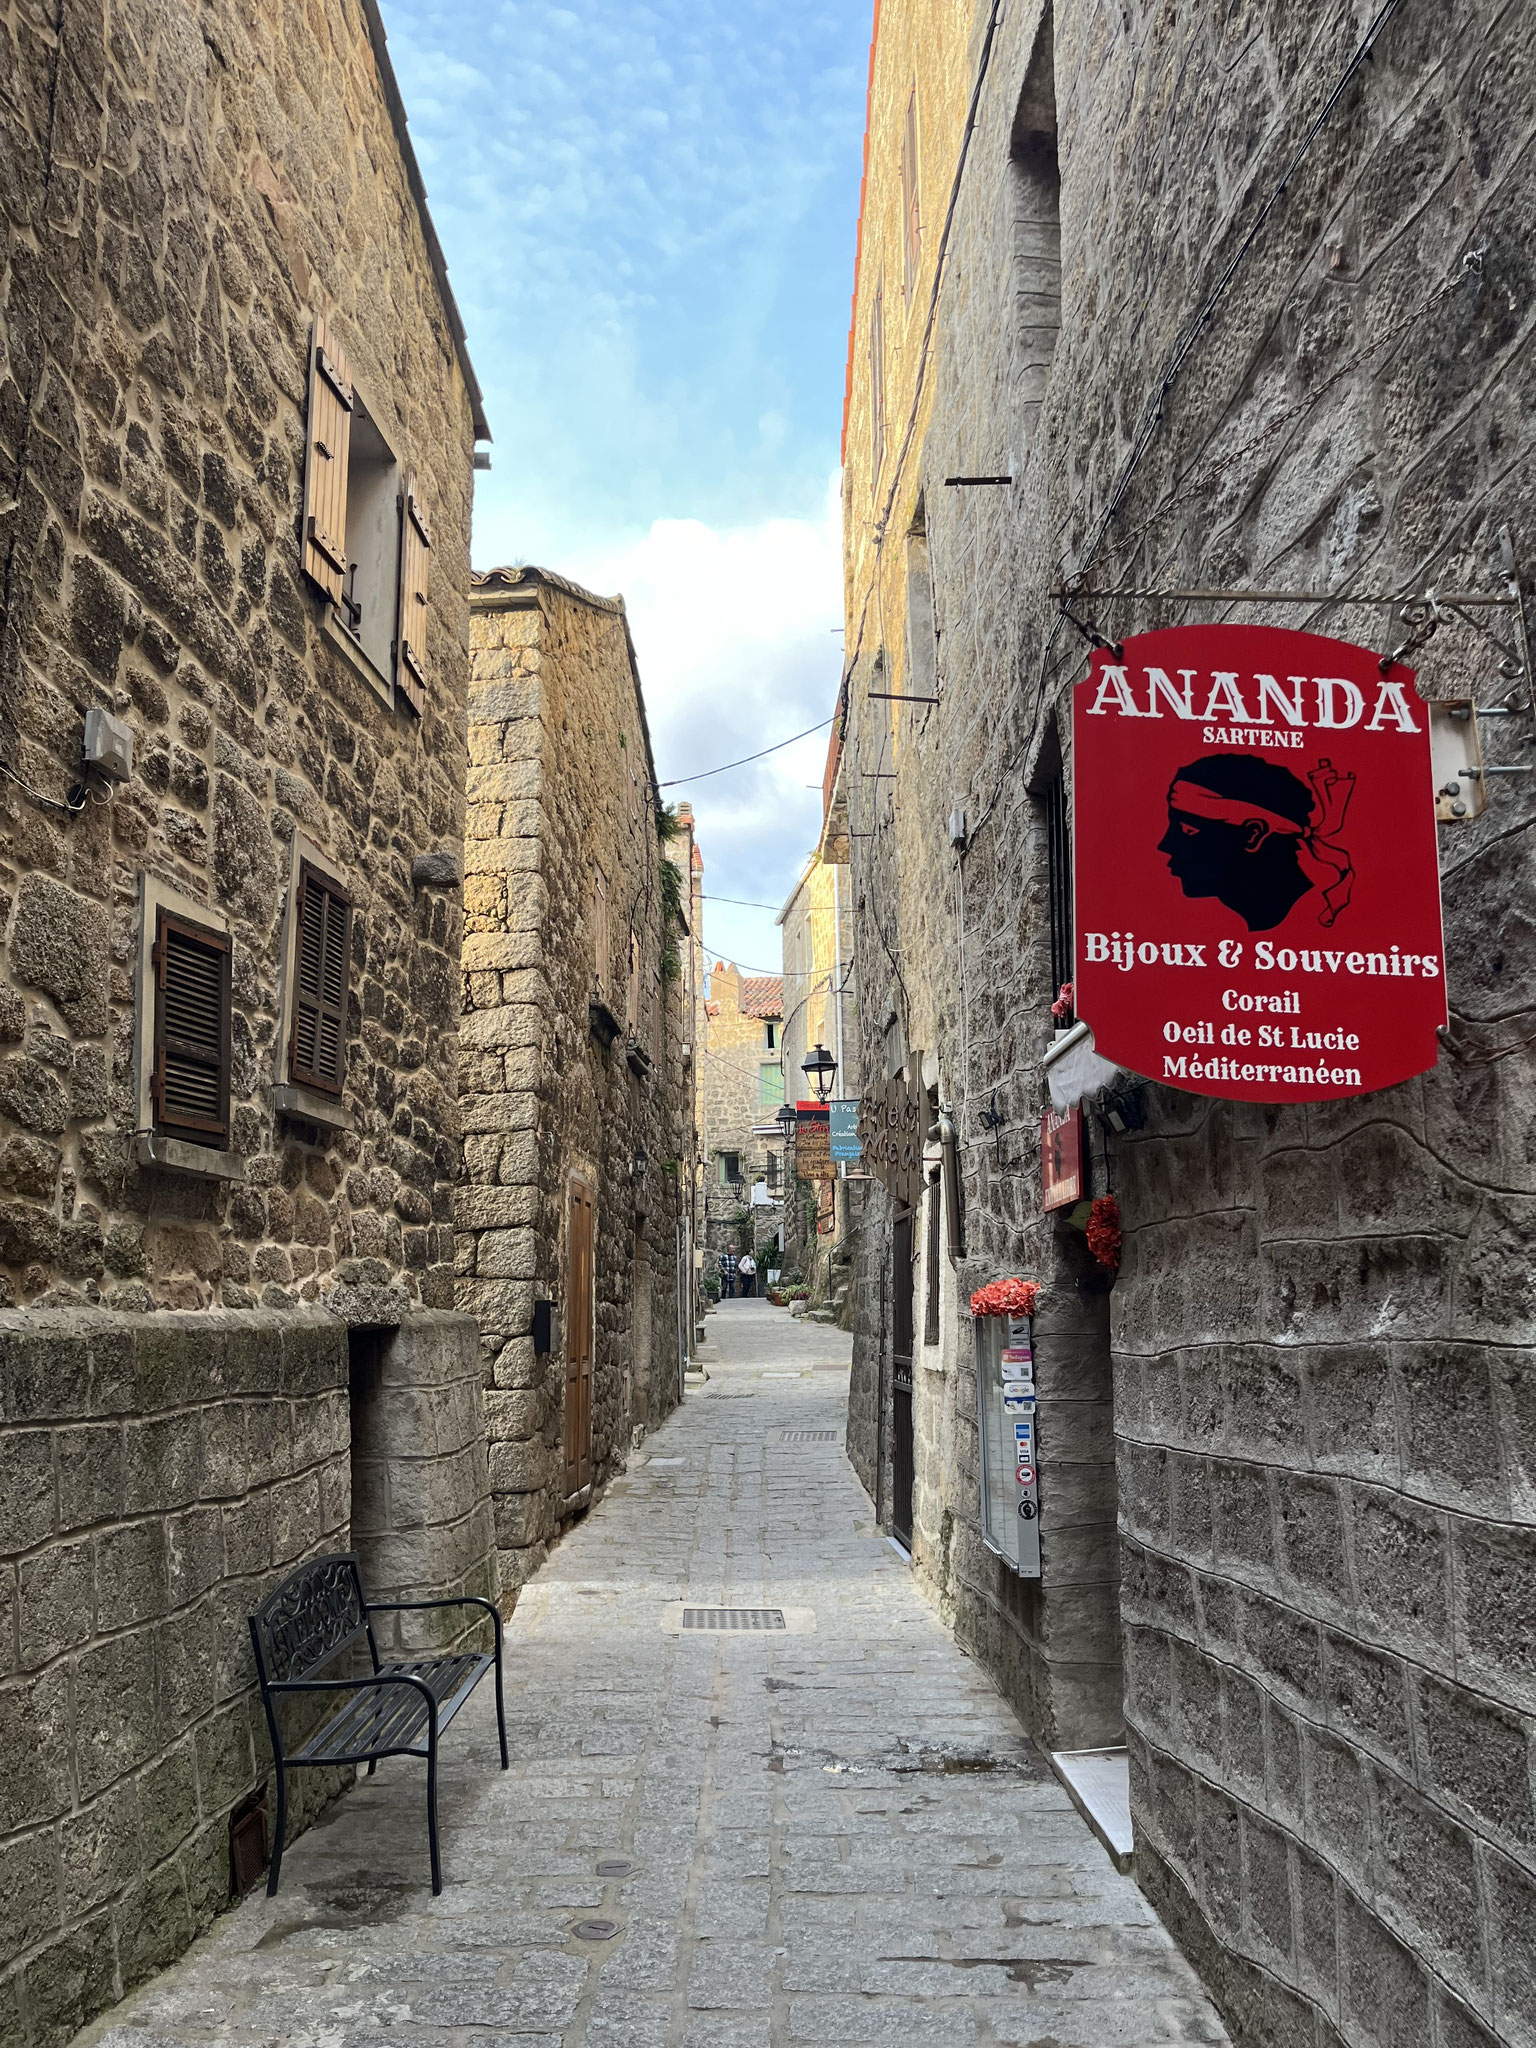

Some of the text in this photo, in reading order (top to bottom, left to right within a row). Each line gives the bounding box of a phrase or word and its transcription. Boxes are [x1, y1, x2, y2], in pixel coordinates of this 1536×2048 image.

[1086, 664, 1422, 734] ANANDA
[1203, 726, 1304, 749] SARTENE
[1085, 932, 1440, 978] Bijoux & Souvenirs
[1222, 990, 1301, 1014] Corail
[1163, 1021, 1360, 1051] Oeil de St Lucie
[1163, 1052, 1362, 1086] Méditerranéen
[1009, 1387, 1030, 1395] Google
